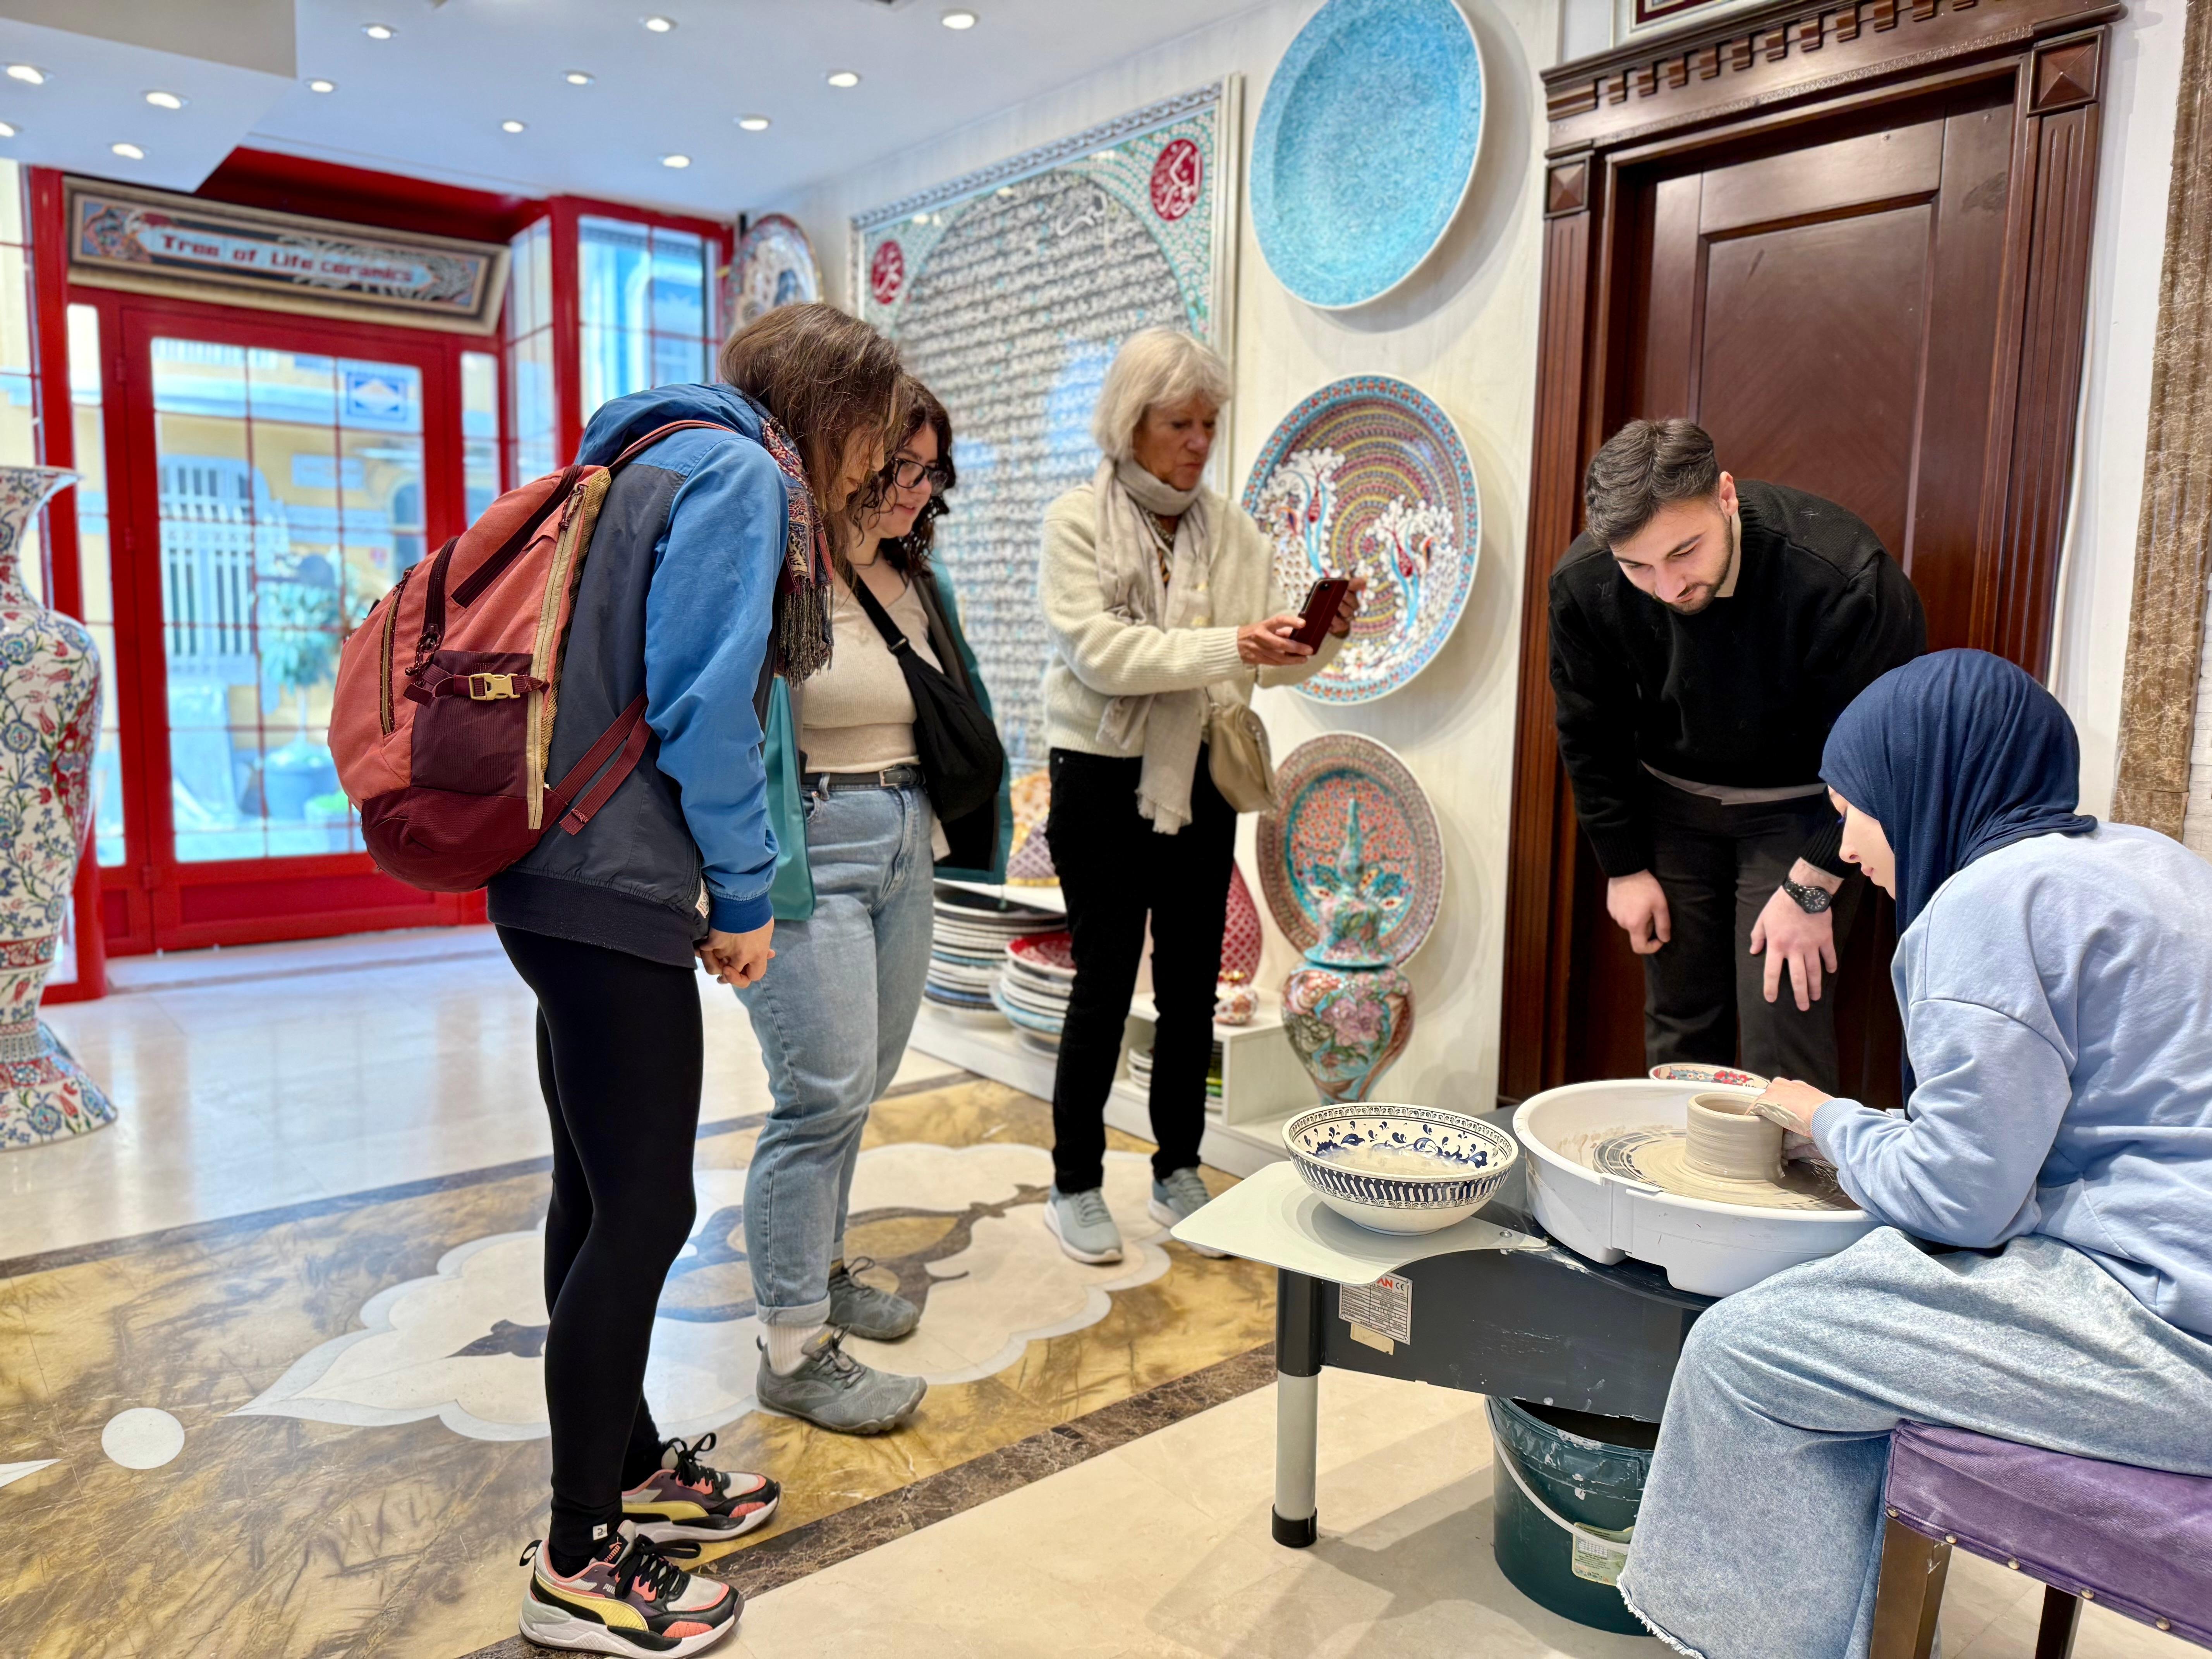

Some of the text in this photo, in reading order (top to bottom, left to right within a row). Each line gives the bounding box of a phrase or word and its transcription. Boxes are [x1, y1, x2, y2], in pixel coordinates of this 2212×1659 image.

[163, 234, 413, 282] Tree of Life ceramics
[603, 1544, 621, 1563] PUMA
[603, 1583, 616, 1594] PUM
